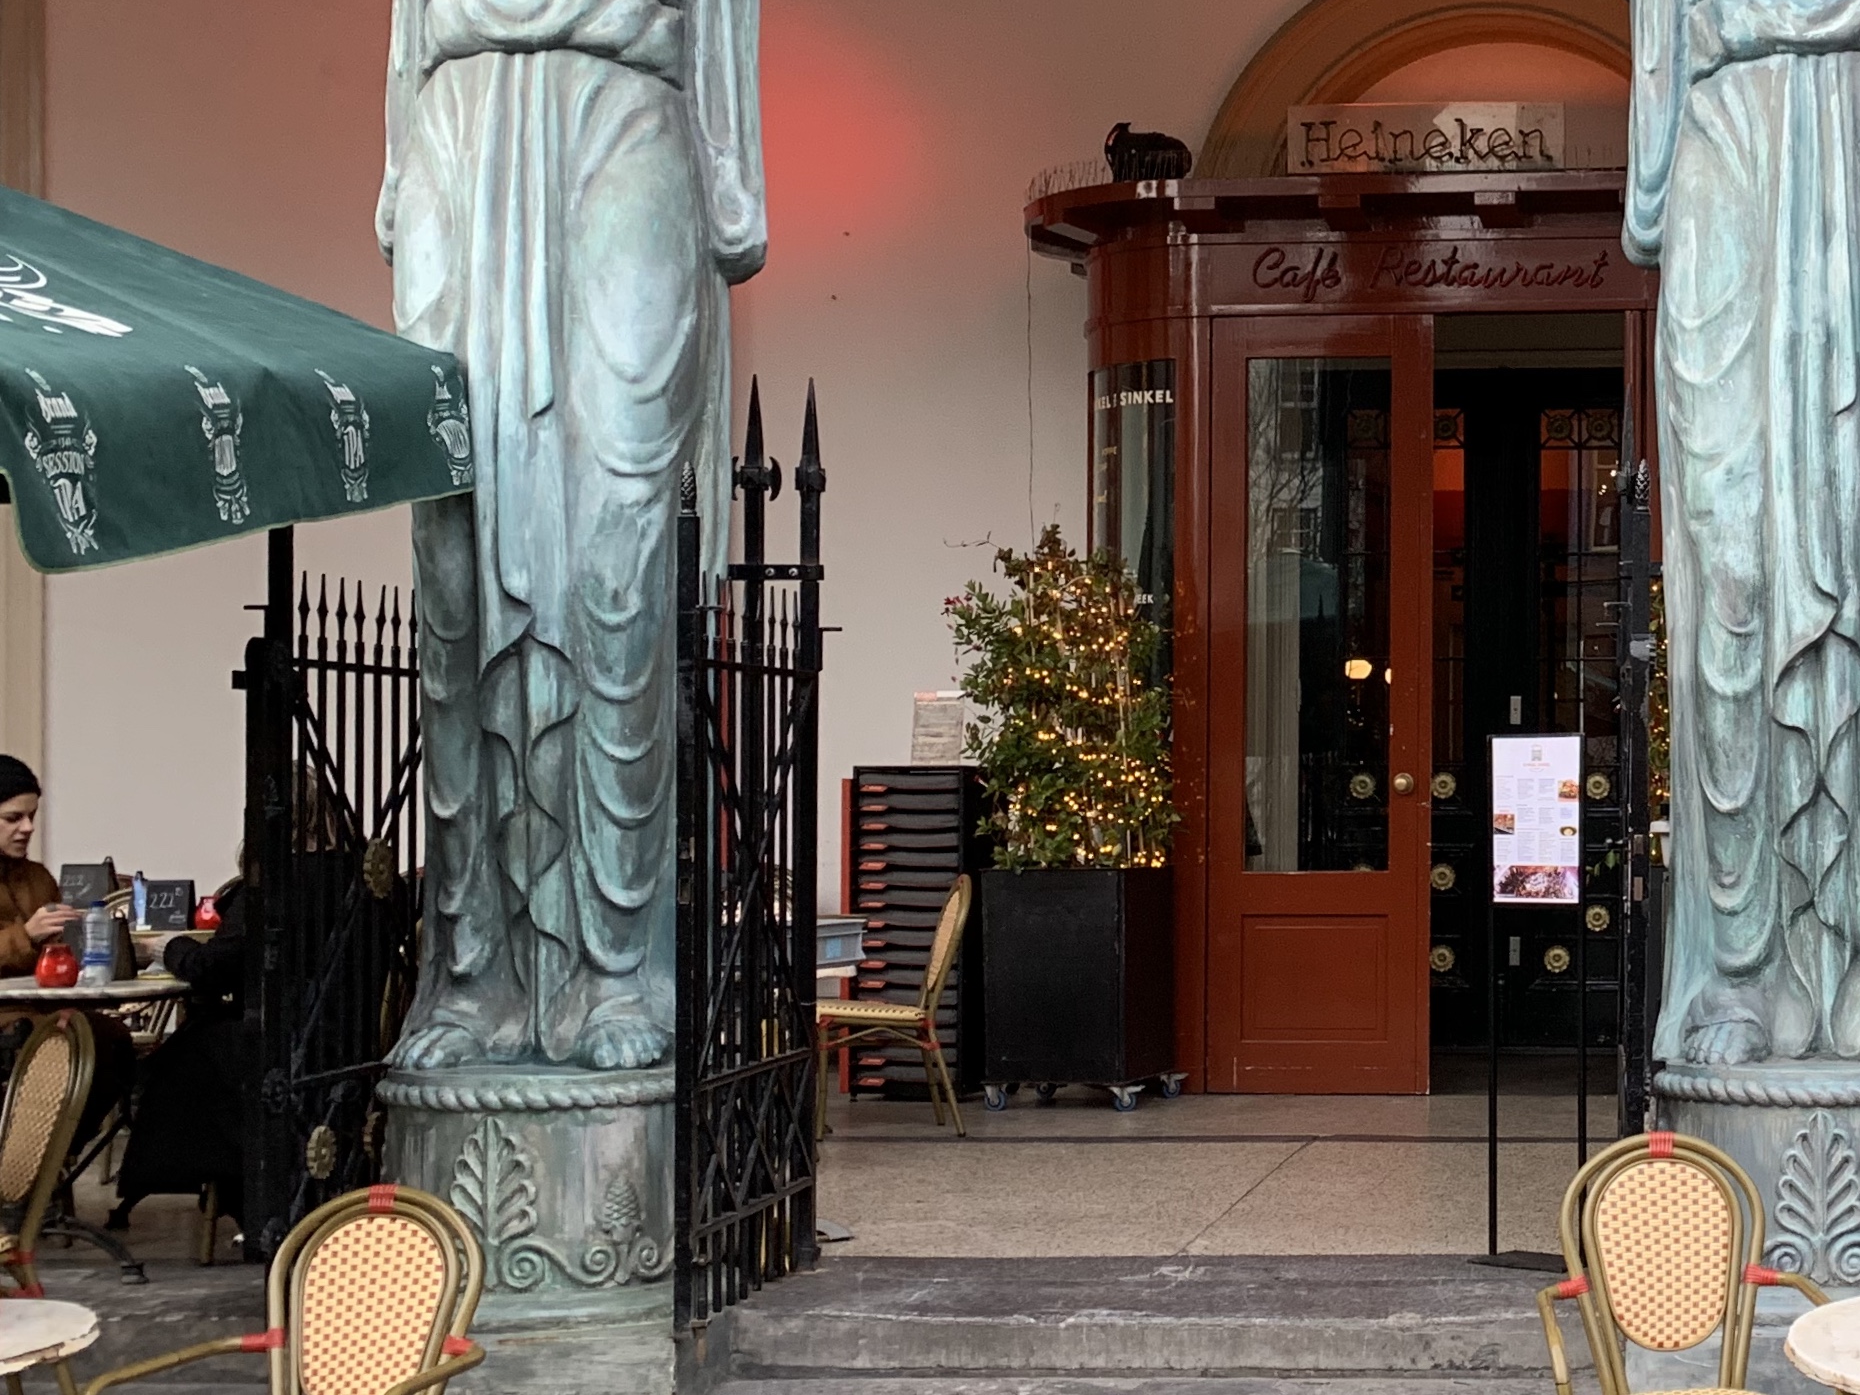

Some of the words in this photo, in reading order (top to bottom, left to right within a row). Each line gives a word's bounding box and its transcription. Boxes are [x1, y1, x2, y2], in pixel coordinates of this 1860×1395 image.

[1300, 118, 1554, 167] Heineken
[1252, 247, 1342, 303] Café
[1368, 245, 1609, 292] Restaurant
[1119, 389, 1174, 407] SINKEL
[42, 451, 85, 479] SESSION
